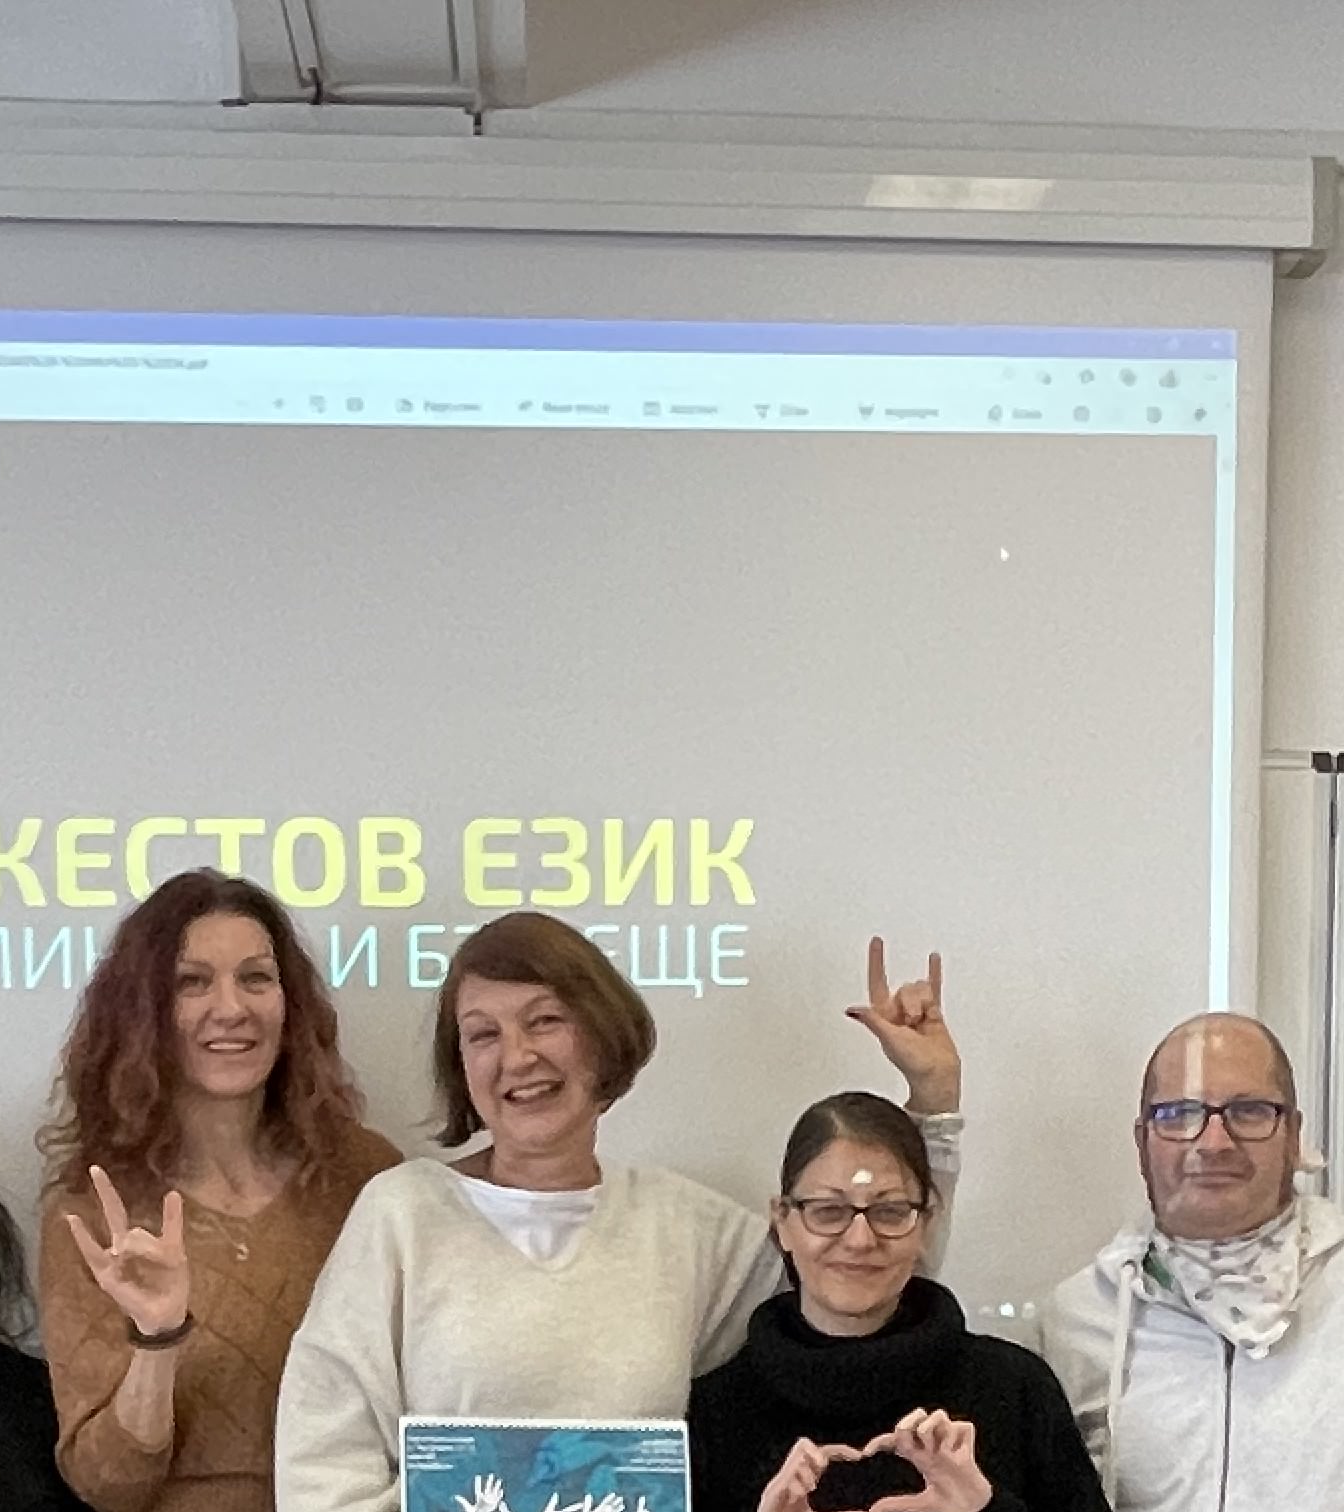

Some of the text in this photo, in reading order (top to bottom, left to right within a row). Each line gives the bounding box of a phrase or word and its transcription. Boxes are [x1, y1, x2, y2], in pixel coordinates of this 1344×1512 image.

[462, 816, 756, 908] ЕЗИК
[329, 924, 751, 999] И БЩЕ
